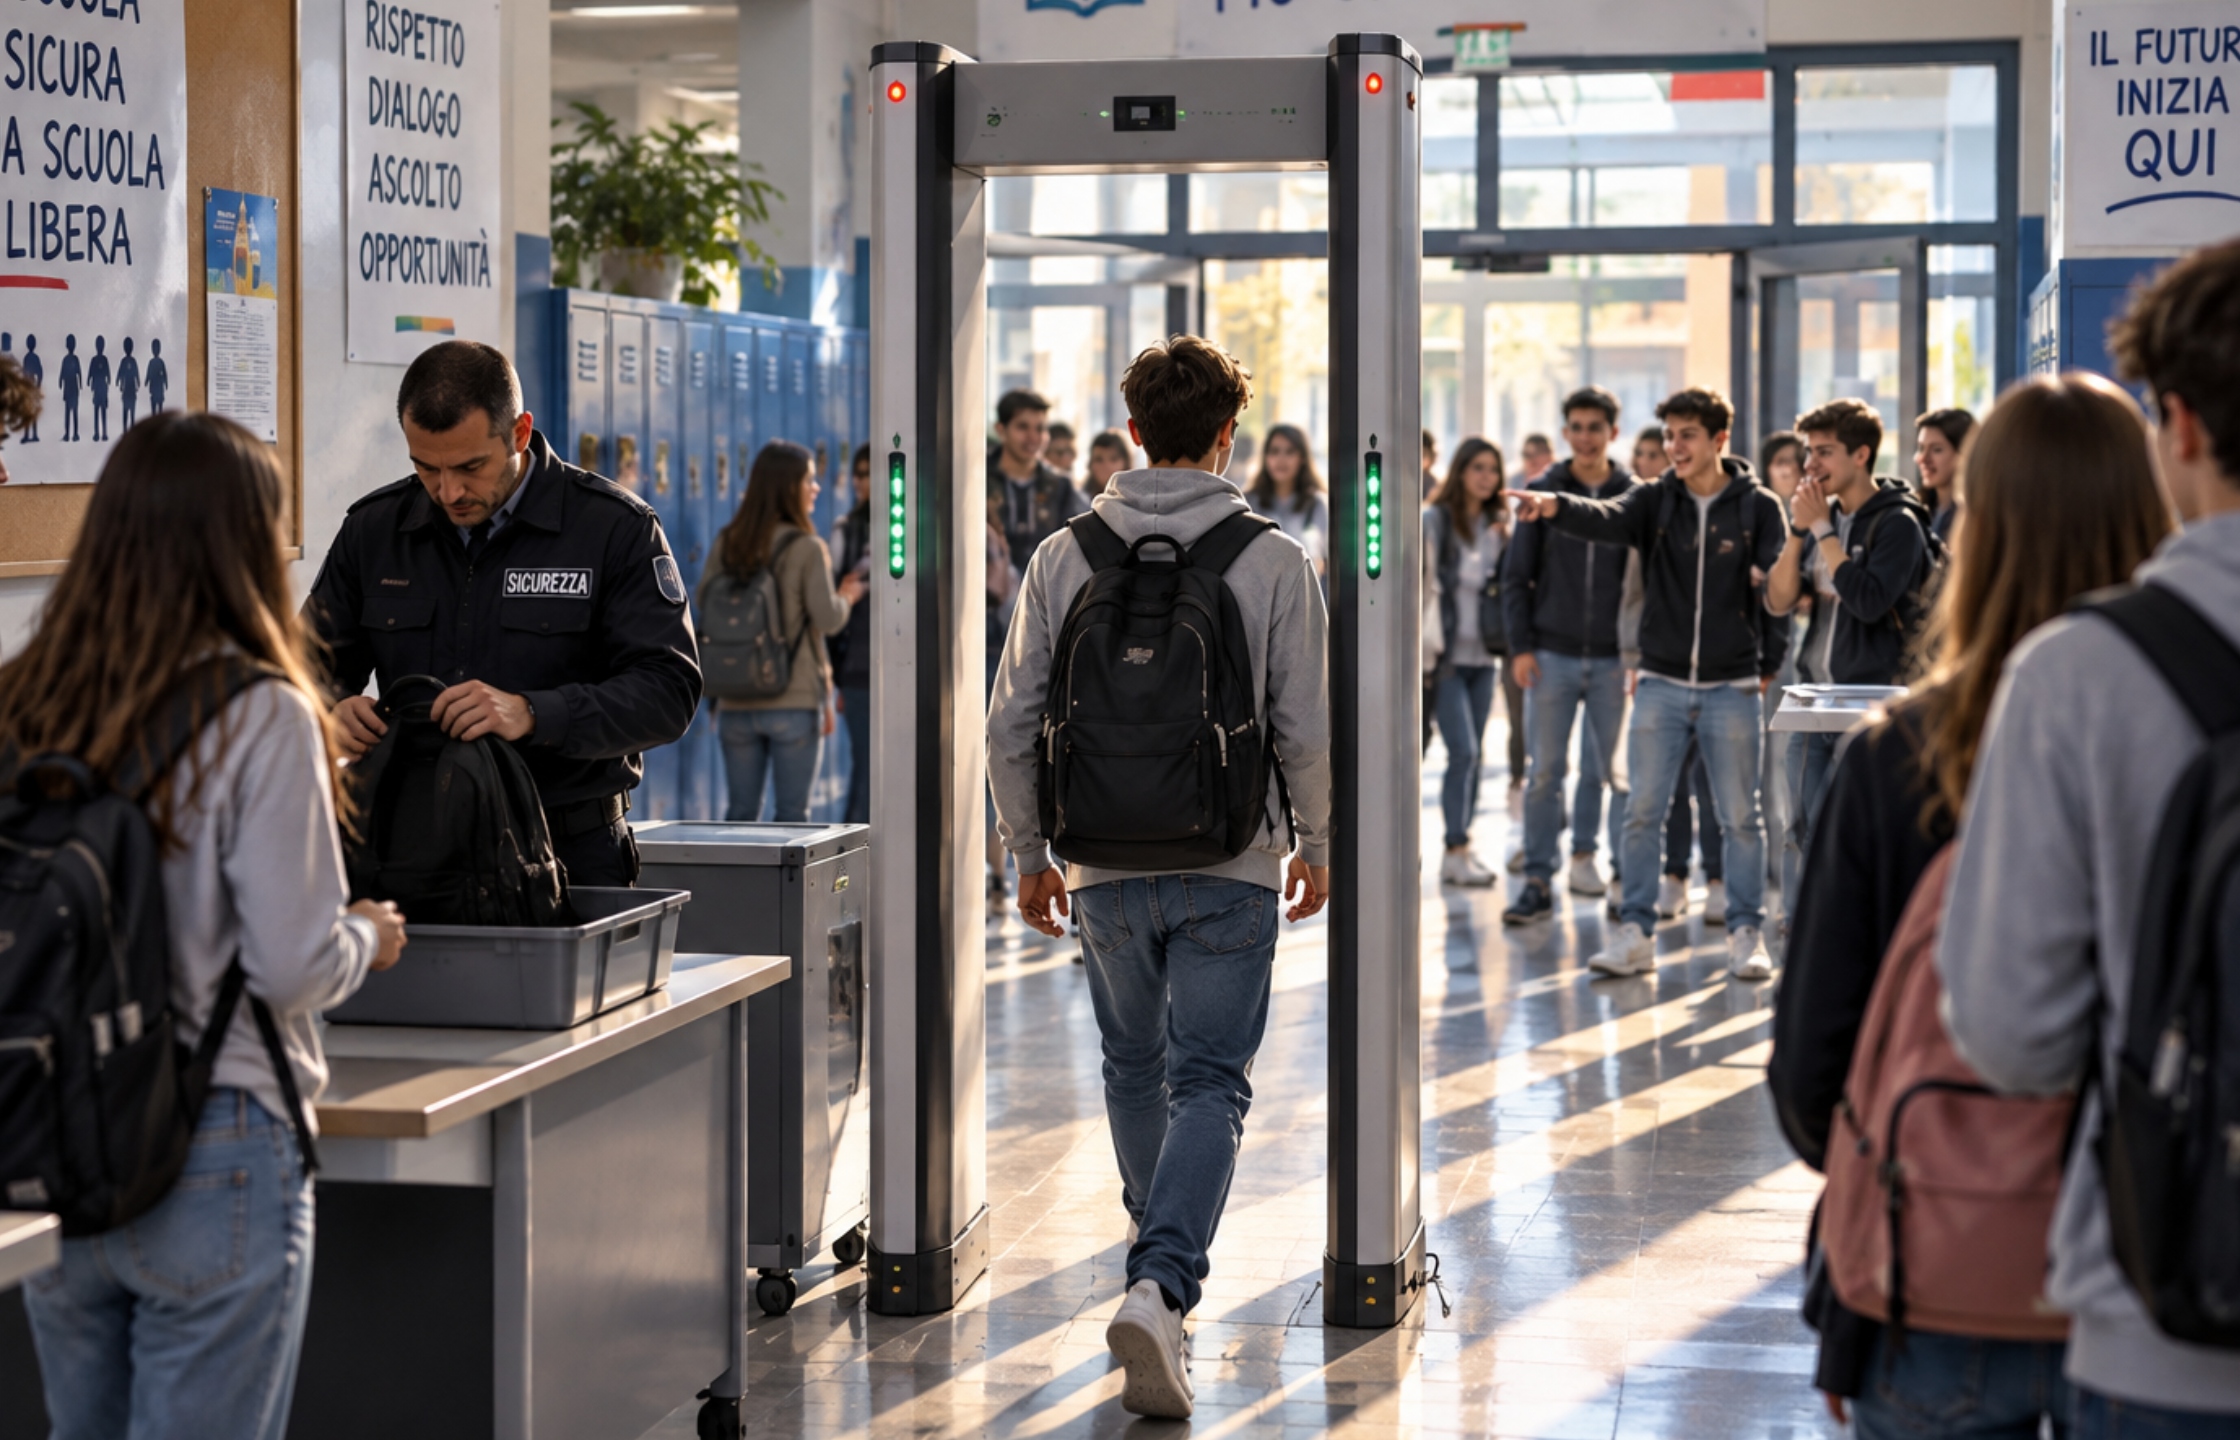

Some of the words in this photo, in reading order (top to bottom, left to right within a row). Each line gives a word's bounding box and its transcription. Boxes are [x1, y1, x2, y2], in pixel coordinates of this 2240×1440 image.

[366, 0, 465, 69] RISPETTO
[2090, 30, 2119, 67] IL
[4, 28, 126, 105] SICURA
[2117, 75, 2230, 116] INIZIA
[368, 75, 461, 139] DIALOGO
[43, 119, 165, 190] SCUOLA
[367, 152, 462, 211] ASCOLTO
[2125, 127, 2216, 182] QUI
[6, 199, 132, 266] LIBERA
[359, 227, 491, 288] OPPORTUNITÀ
[506, 572, 588, 594] SICUREZZA
